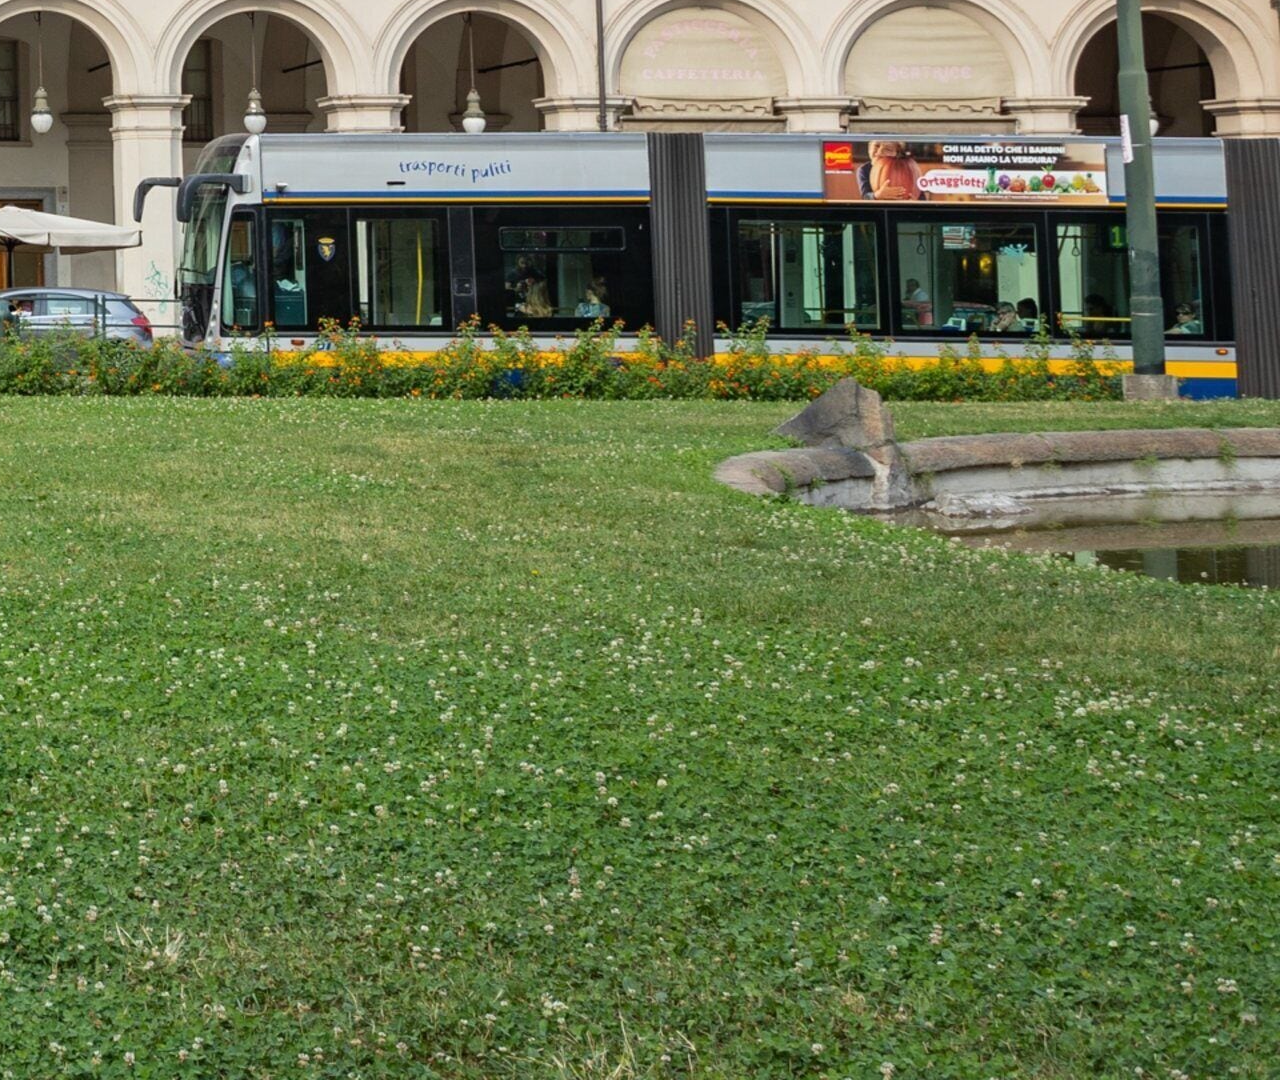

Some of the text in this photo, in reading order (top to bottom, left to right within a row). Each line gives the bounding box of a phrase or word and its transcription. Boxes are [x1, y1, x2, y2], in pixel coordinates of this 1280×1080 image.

[642, 68, 765, 80] CAFFETTERIA
[942, 145, 959, 154] CHI
[959, 145, 973, 154] HA
[974, 145, 1004, 154] DETTO
[1004, 145, 1023, 154] CHE
[1028, 145, 1066, 154] BAMBINI
[942, 155, 1058, 164] NON AMANO LA VERDURA?
[399, 159, 512, 183] trasporti puliti
[919, 175, 986, 189] Ortaggiotti
